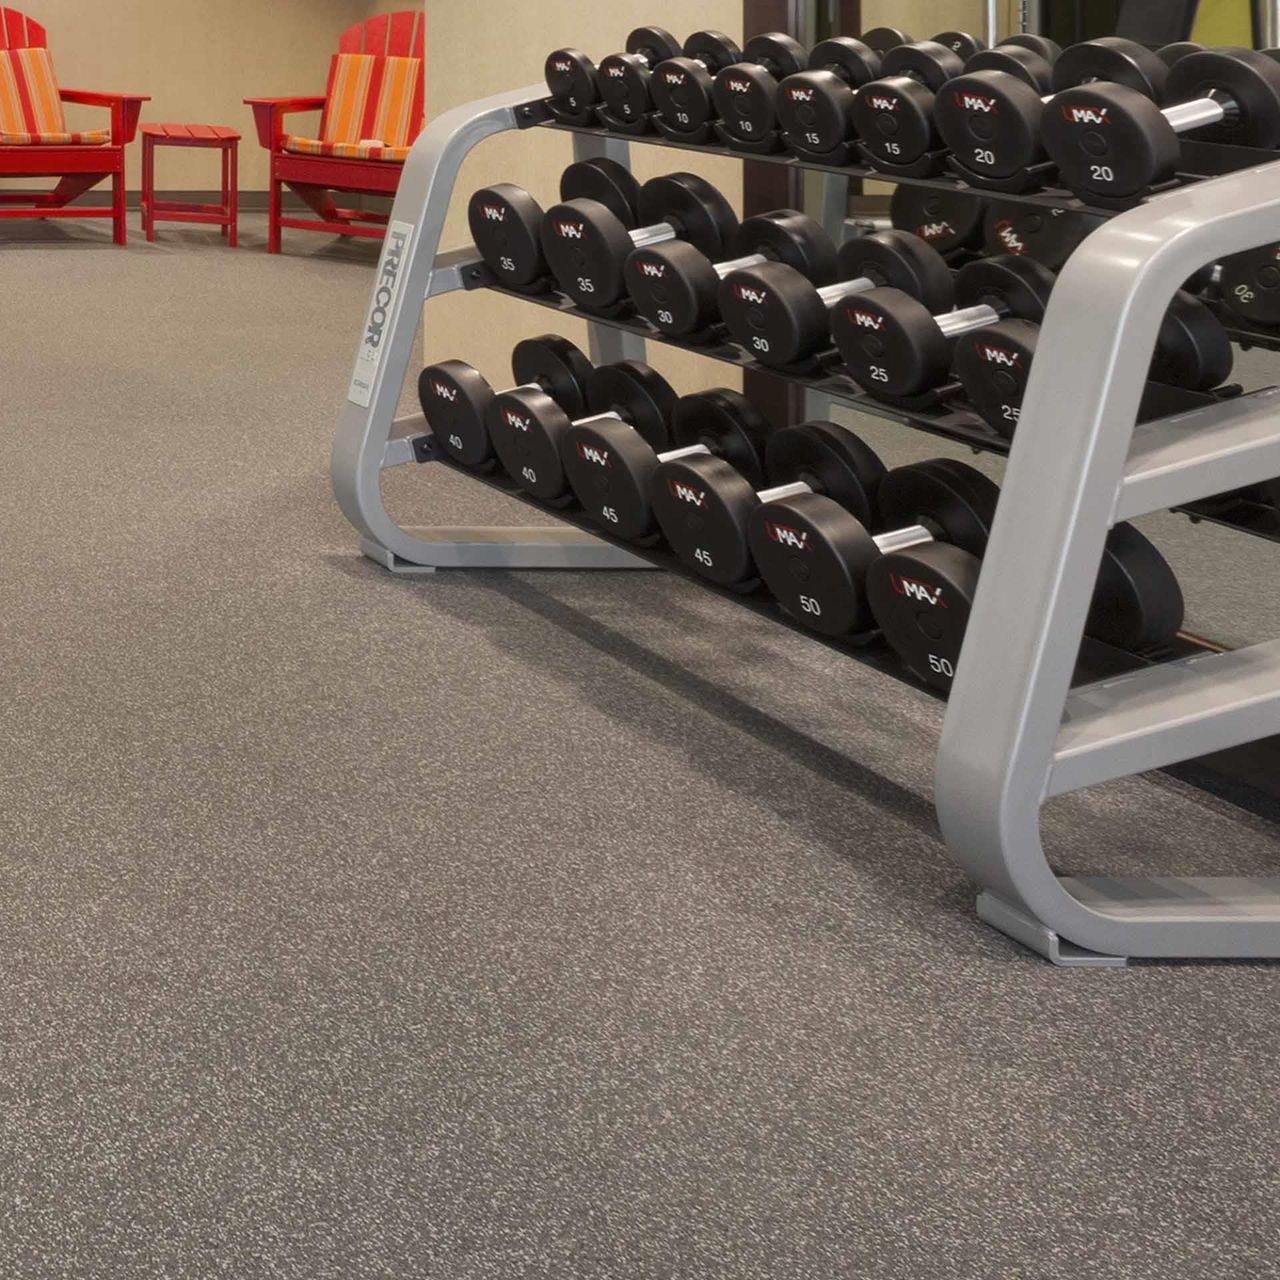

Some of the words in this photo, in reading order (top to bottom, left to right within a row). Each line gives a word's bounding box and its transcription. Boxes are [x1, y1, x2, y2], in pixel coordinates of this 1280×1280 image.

[569, 97, 576, 107] 5
[623, 104, 631, 114] 5
[676, 112, 689, 124] 10
[738, 120, 753, 132] 10
[805, 131, 820, 145] 15
[884, 141, 900, 155] 15
[974, 147, 996, 165] 20
[1089, 164, 1114, 182] 20
[500, 255, 516, 271] 35
[364, 231, 408, 349] PRECOR
[576, 276, 595, 293] 35
[657, 308, 673, 325] 30
[751, 335, 770, 353] 30
[869, 364, 889, 383] 25
[1000, 404, 1021, 422] 25
[448, 434, 463, 450] 40
[521, 466, 537, 483] 40
[601, 505, 619, 524] 45
[693, 547, 713, 567] 45
[799, 593, 822, 616] 50
[927, 652, 954, 678] 50
